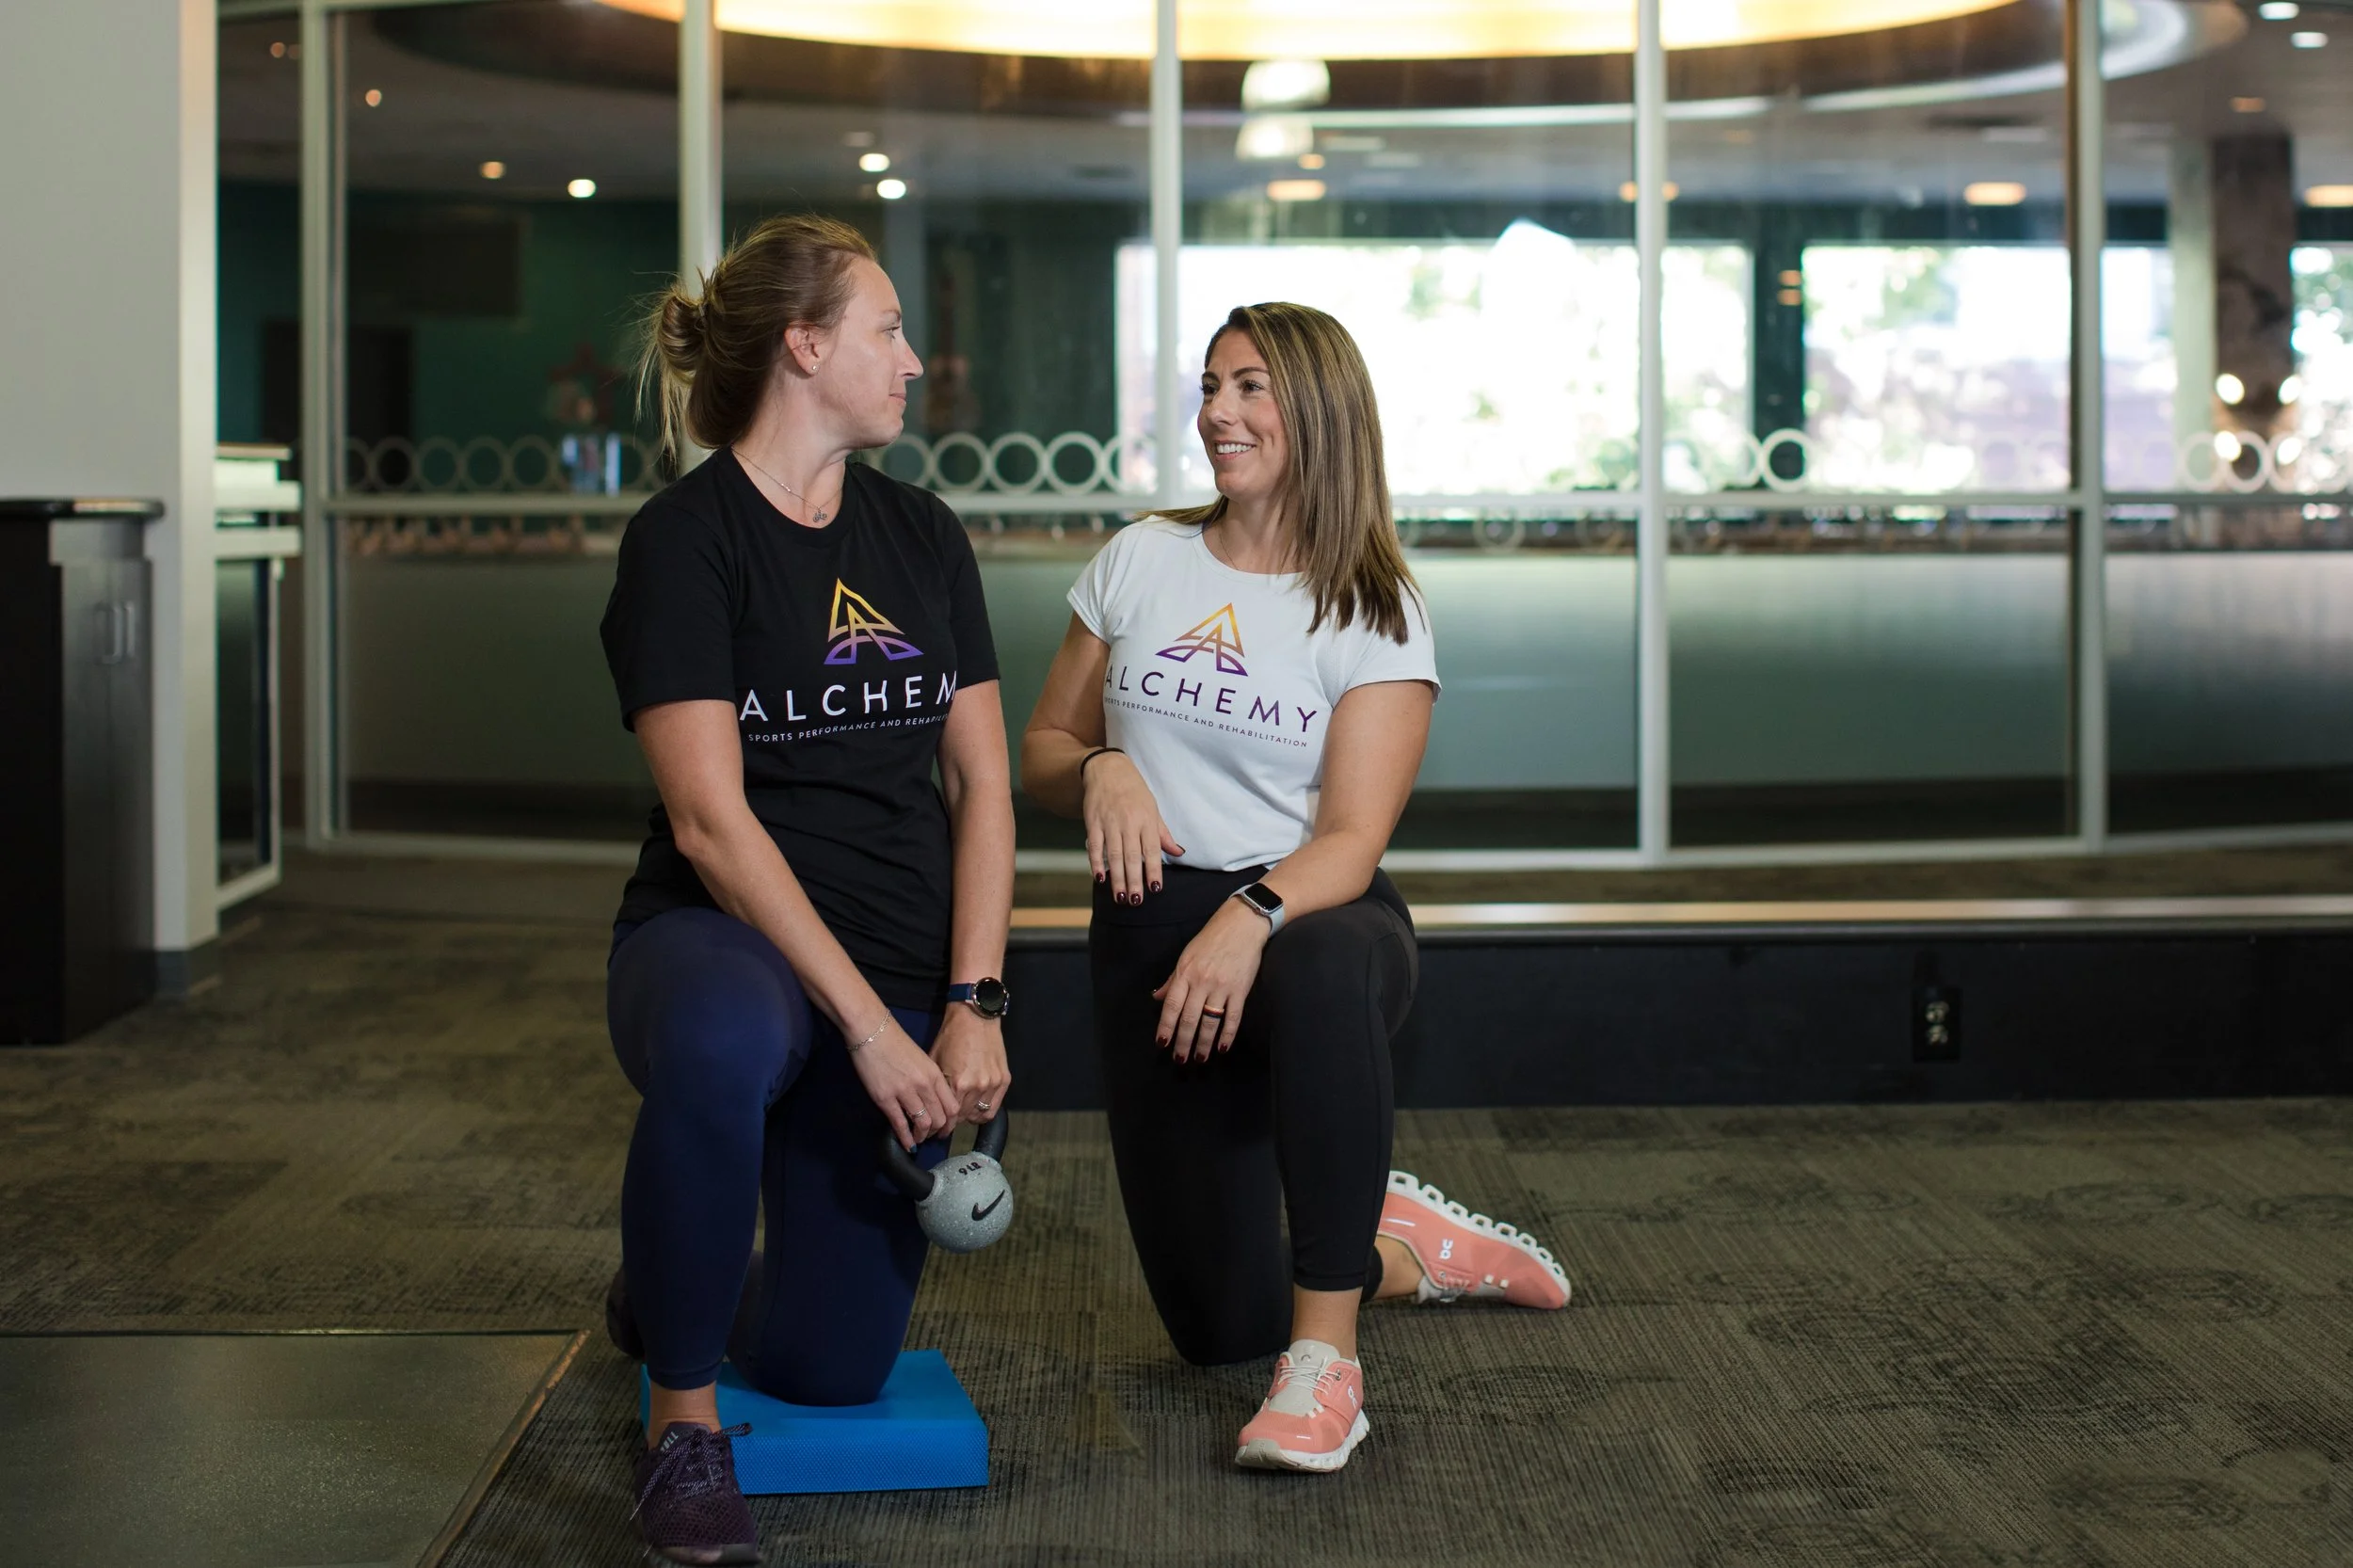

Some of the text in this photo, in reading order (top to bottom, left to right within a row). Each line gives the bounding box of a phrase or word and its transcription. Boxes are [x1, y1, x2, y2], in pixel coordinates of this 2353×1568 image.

[1105, 664, 1318, 732] ALCHEMY
[748, 733, 792, 743] SPORTS
[799, 721, 876, 739] PERFORMANCE
[880, 718, 902, 728] AND
[1122, 701, 1190, 722] PERFORMANCE
[1194, 717, 1214, 728] AND
[1219, 724, 1307, 747] REHABILITATION
[958, 1167, 968, 1176] 9
